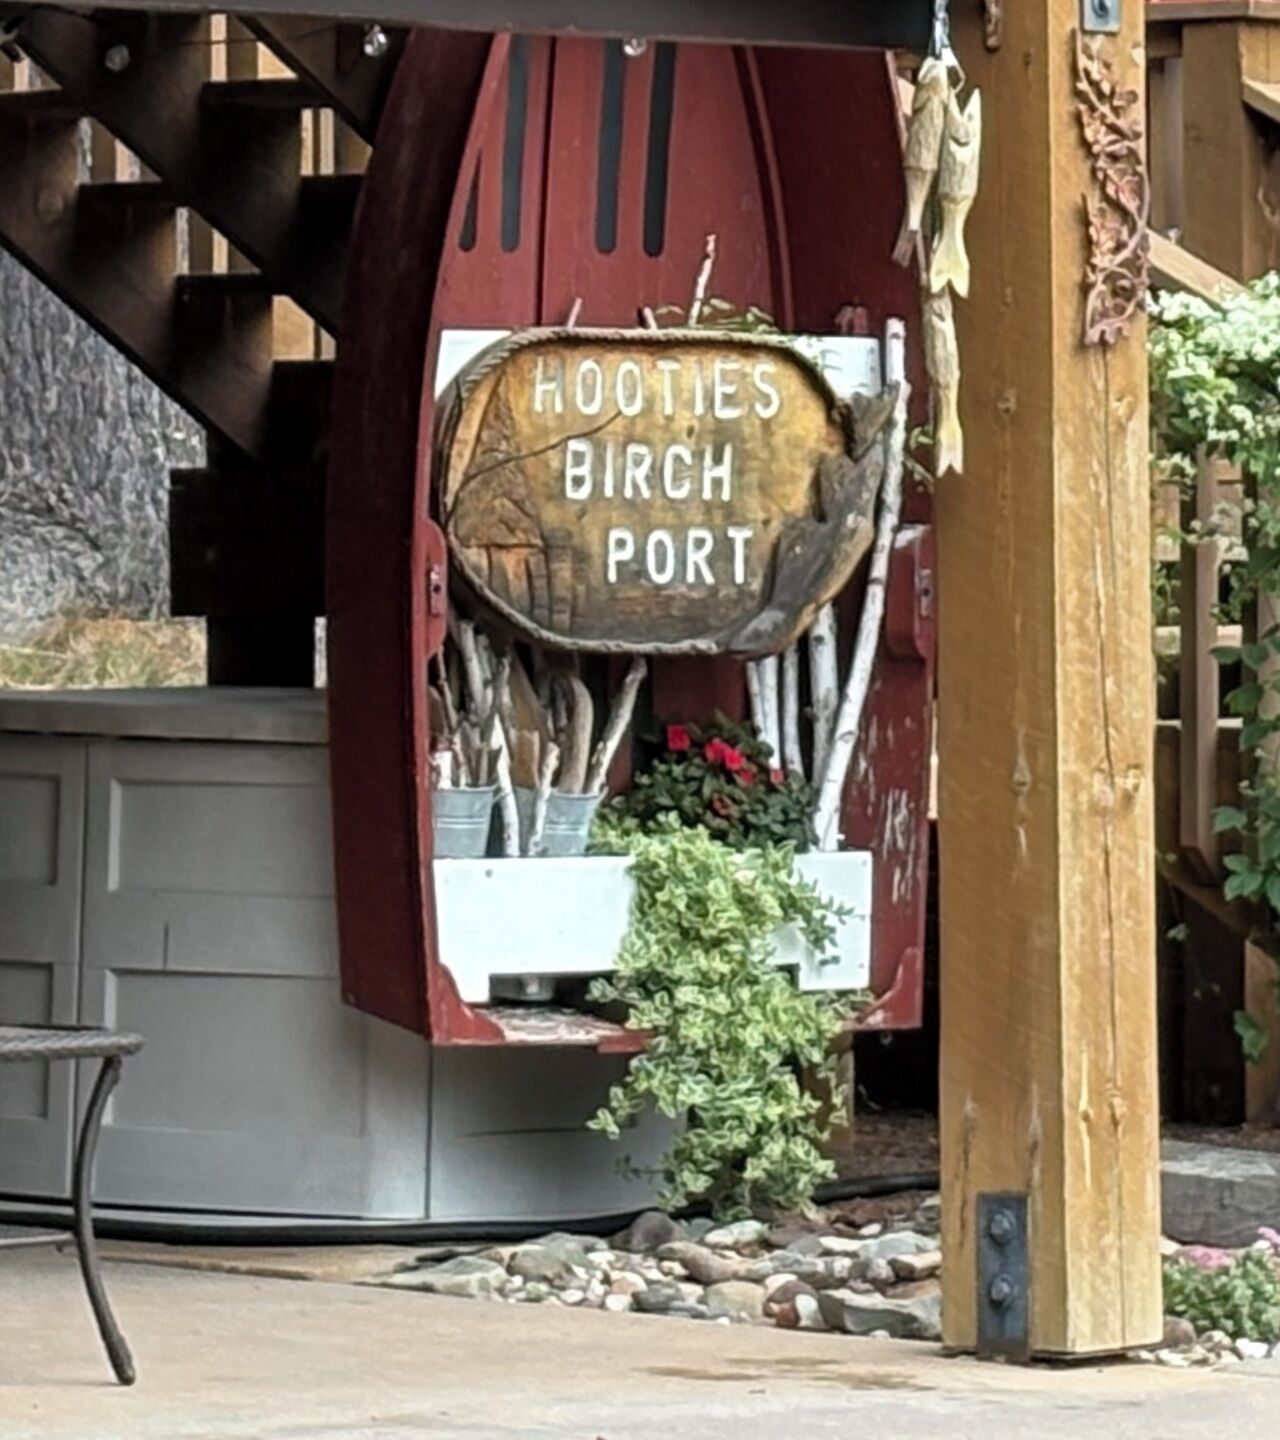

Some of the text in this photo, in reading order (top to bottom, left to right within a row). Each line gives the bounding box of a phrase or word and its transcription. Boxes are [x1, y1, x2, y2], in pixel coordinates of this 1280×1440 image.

[533, 358, 781, 419] HOOTIES
[565, 440, 732, 502] BIRCH
[607, 527, 753, 584] PORT
